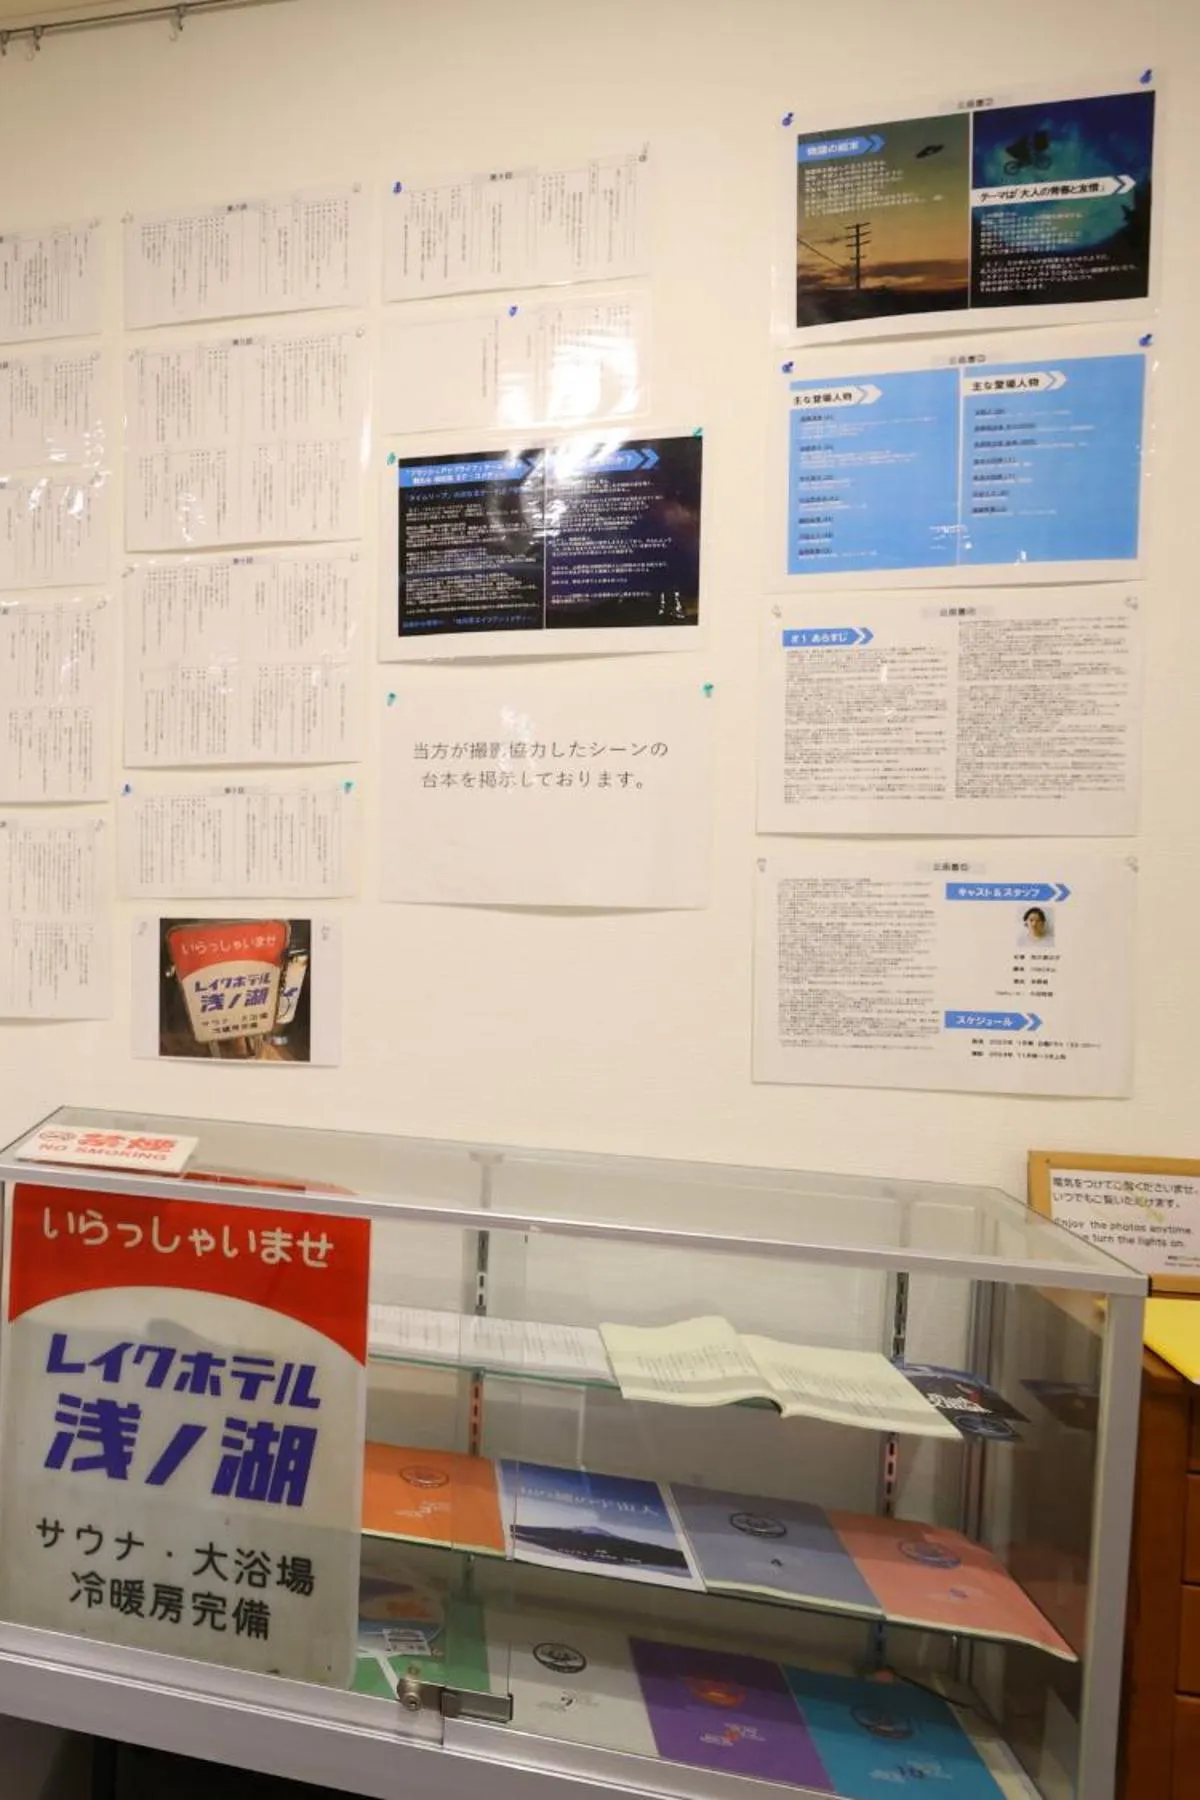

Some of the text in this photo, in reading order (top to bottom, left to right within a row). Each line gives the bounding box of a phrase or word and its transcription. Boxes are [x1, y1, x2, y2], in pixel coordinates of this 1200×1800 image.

[971, 376, 1041, 393] 主な登場人物
[413, 740, 669, 761] 当方が撮影協力したシーンの
[421, 769, 645, 790] 台本を掲示しております。
[181, 934, 277, 955] いらっしゃいませ
[194, 972, 272, 993] レイクホテル
[200, 987, 270, 1013] 浅ノ湖
[956, 1015, 1014, 1028] スケジュール
[38, 1143, 168, 1161] NO SMOKING
[78, 1132, 176, 1152] 禁煙
[1090, 1218, 1109, 1230] the
[1110, 1221, 1147, 1234] photos
[41, 1206, 334, 1269] いらっしゃいませ
[1092, 1232, 1116, 1244] turn
[1117, 1234, 1136, 1245] the
[1138, 1236, 1167, 1249] lights
[45, 1332, 322, 1410] レイクホテル
[43, 1393, 319, 1507] 浅ノ湖
[35, 1516, 316, 1597] サウナ・大浴場
[68, 1569, 273, 1641] 冷暖房完備
